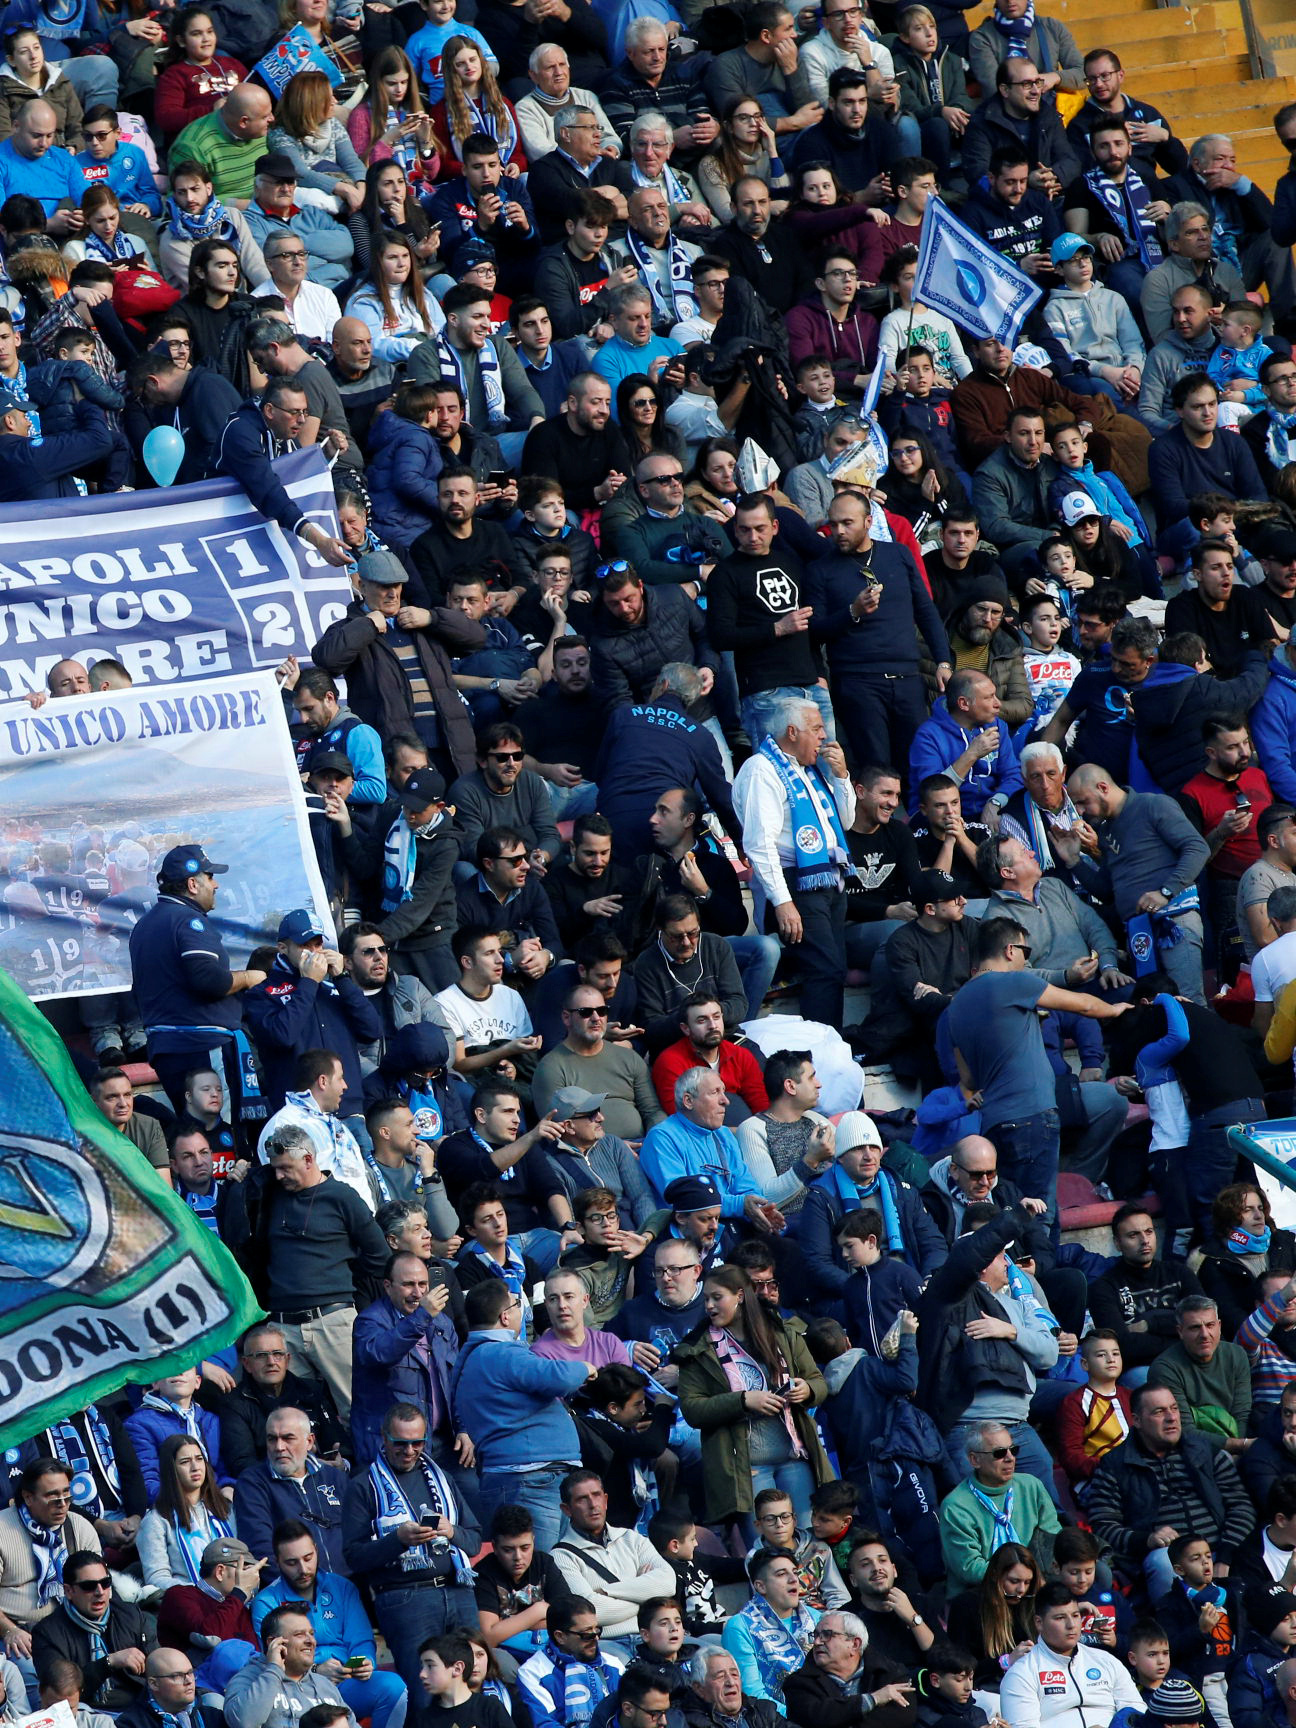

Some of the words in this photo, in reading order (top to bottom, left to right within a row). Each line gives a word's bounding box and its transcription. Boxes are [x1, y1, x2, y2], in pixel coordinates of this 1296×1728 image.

[85, 167, 110, 179] Lete
[225, 538, 270, 577] 1
[253, 602, 295, 648] 2
[1038, 662, 1072, 681] Lete
[5, 706, 127, 756] UNICO
[137, 689, 266, 739] AMORE
[631, 706, 697, 732] NAPOLI
[487, 1017, 517, 1035] COAST
[213, 1156, 236, 1174] ete
[909, 1472, 929, 1514] GIVOVA
[1215, 1643, 1231, 1655] 23
[1042, 1671, 1065, 1683] Lete
